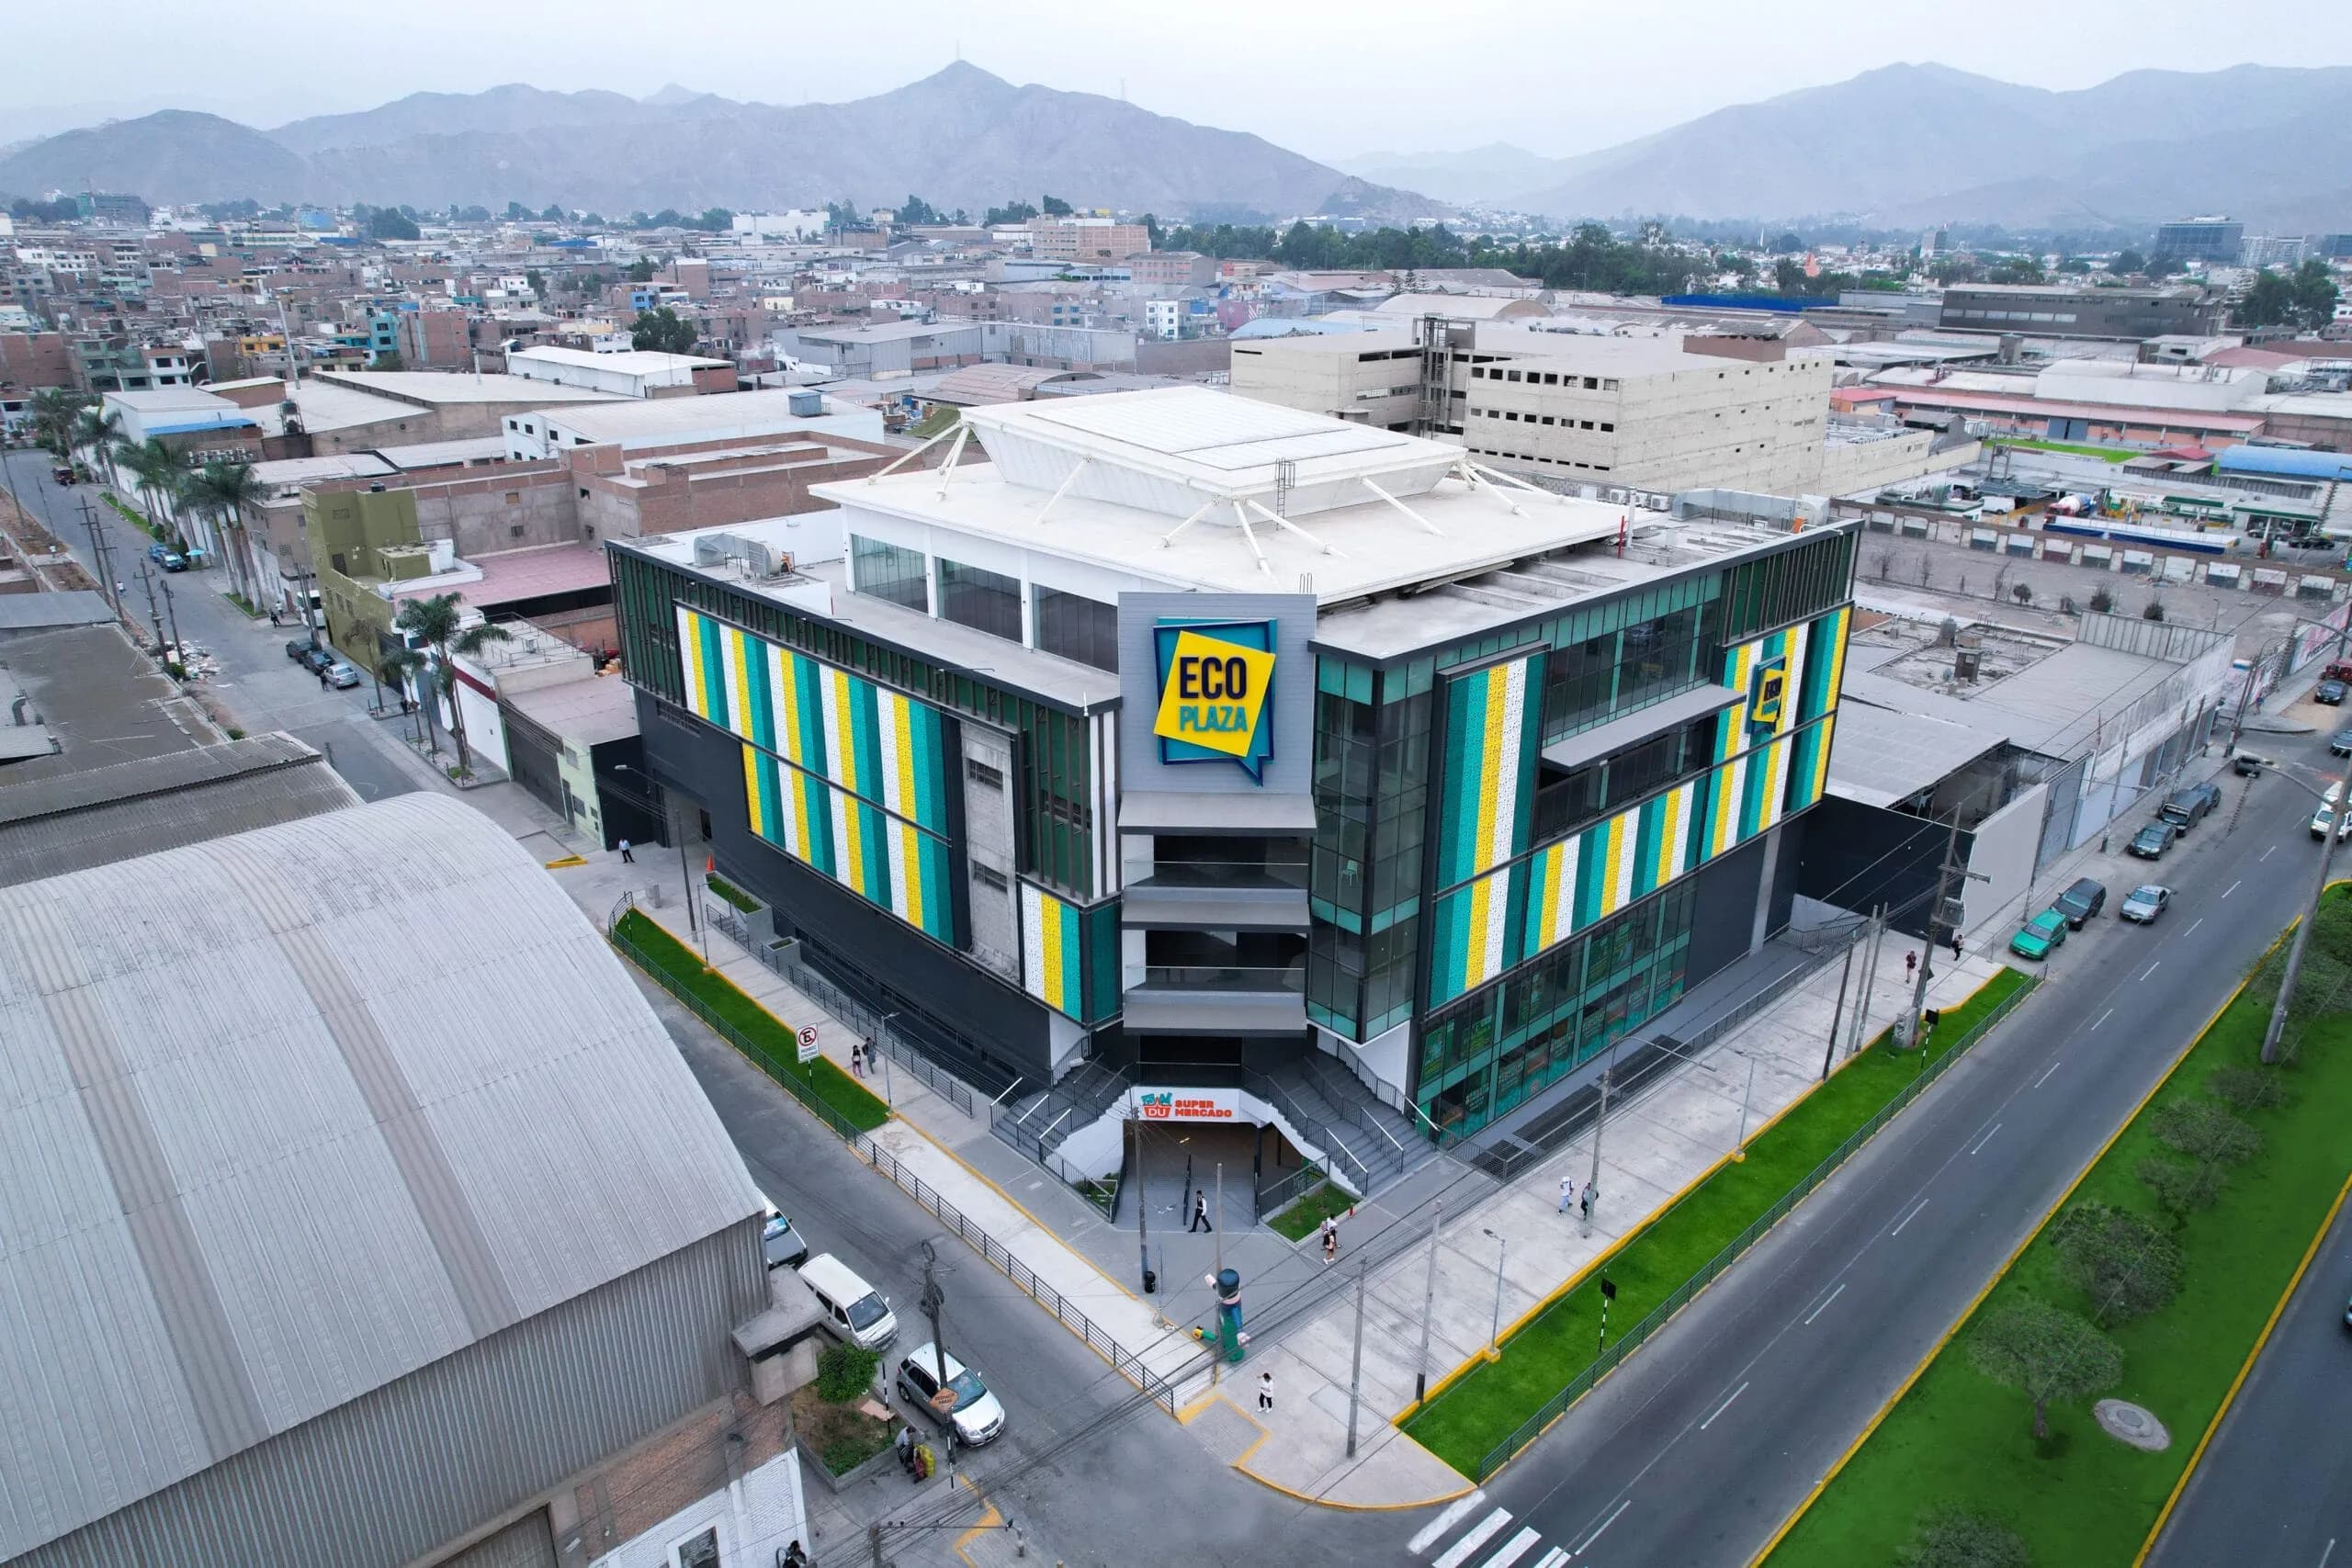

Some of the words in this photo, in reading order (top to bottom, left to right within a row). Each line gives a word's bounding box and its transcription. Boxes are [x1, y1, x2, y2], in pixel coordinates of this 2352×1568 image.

[1179, 656, 1247, 700] ECO
[1179, 705, 1248, 732] PLAZA
[1175, 1100, 1215, 1108] SUPER
[1148, 1108, 1166, 1117] DU
[1175, 1109, 1232, 1117] MERCADO
